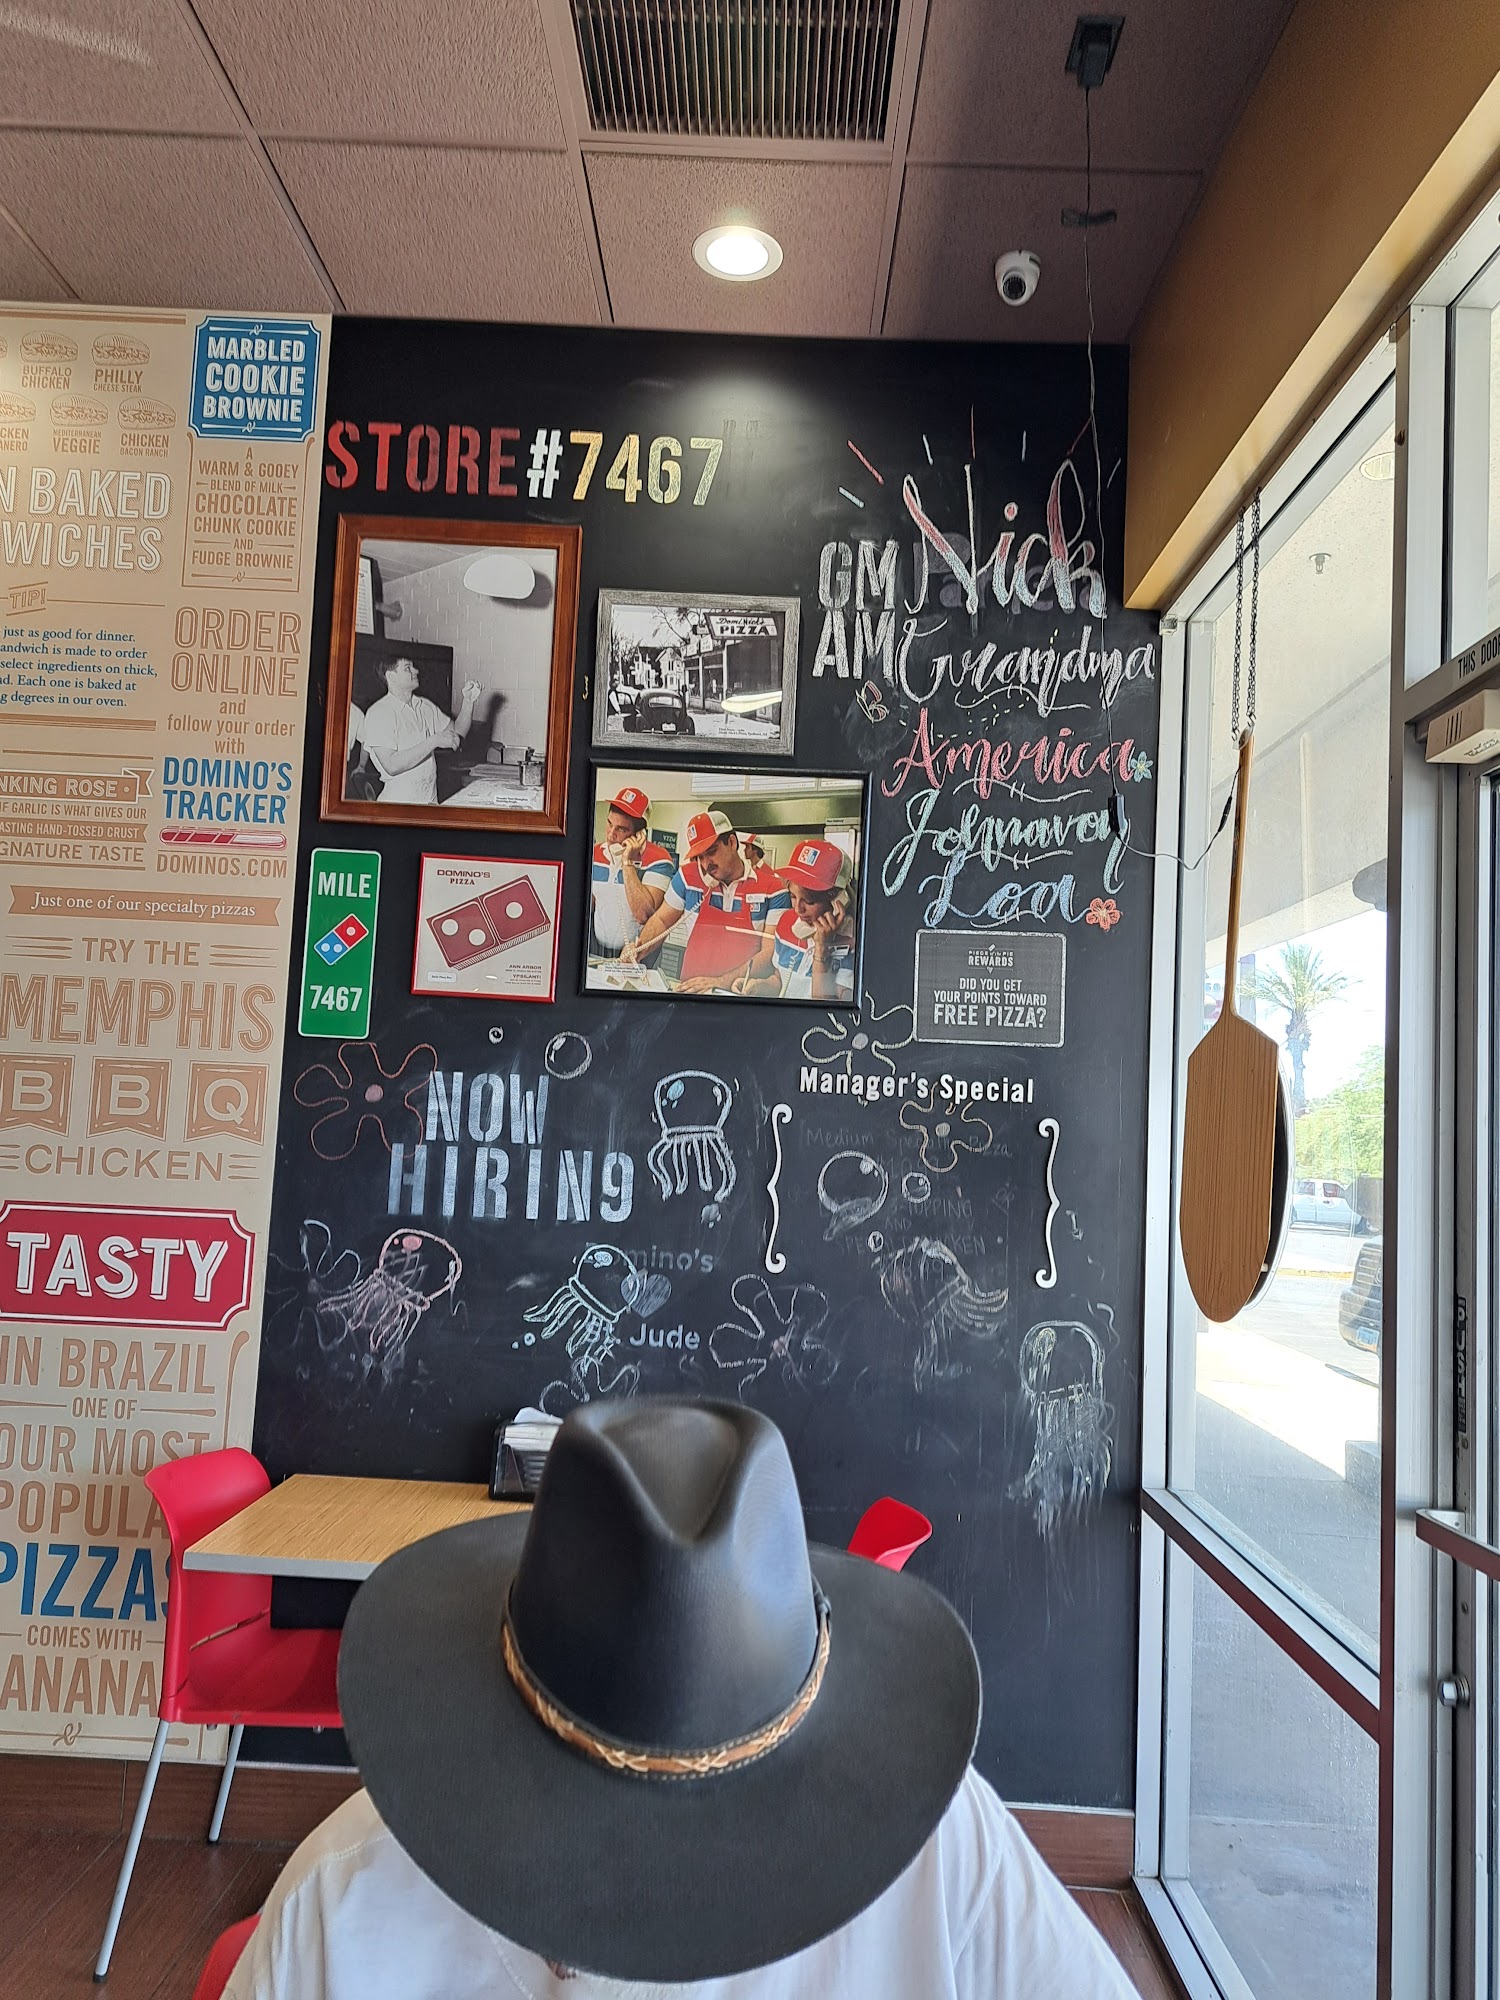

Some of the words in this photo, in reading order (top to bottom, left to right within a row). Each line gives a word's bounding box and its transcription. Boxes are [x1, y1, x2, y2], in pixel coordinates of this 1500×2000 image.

[206, 336, 306, 363] MARBLED
[22, 365, 72, 377] BUFFALO
[94, 369, 144, 384] PHILLY
[205, 363, 306, 396] COOKIE
[21, 375, 71, 390] CHICKEN
[93, 383, 119, 392] CHEESE
[120, 385, 142, 393] STEAK
[202, 395, 303, 423] BROWNIE
[52, 429, 102, 438] MEDITERRANEAN
[120, 433, 169, 448] CHICKEN
[52, 437, 101, 454] VEGGIE
[119, 448, 144, 457] BACON
[146, 448, 168, 458] RANCH
[245, 447, 253, 460] A
[198, 460, 240, 477] WARM
[243, 461, 253, 477] &
[258, 462, 300, 479] GOOEY
[28, 466, 174, 523] BAKED
[210, 479, 242, 492] BLEND
[244, 481, 256, 492] OF
[259, 481, 283, 494] MILK
[195, 493, 297, 518] CHOCOLATE
[193, 516, 241, 535] CHUNK
[246, 518, 296, 537] COOKIE
[0, 520, 165, 574] WICHES
[233, 538, 254, 551] AND
[191, 551, 231, 567] FUDGE
[235, 552, 294, 569] BROWNIE
[818, 540, 898, 611] GM
[10, 589, 46, 608] TIP!
[3, 626, 24, 639] just
[42, 629, 72, 641] good
[75, 629, 92, 640] for
[96, 630, 135, 642] dinner.
[174, 606, 302, 654] ORDER
[720, 626, 770, 635] PIZZA
[53, 644, 61, 655] is
[65, 645, 96, 656] made
[100, 647, 111, 657] to
[115, 648, 147, 659] order
[813, 609, 895, 680] AM
[1, 658, 33, 669] select
[37, 660, 102, 673] ingredients
[106, 666, 120, 674] on
[124, 664, 158, 678] thick,
[170, 651, 300, 697] ONLINE
[1458, 650, 1476, 680] THIS
[17, 675, 46, 686] Each
[50, 679, 71, 687] one
[75, 678, 84, 688] is
[87, 678, 122, 690] baked
[125, 682, 136, 691] at
[10, 691, 54, 705] degrees
[58, 693, 69, 704] in
[73, 696, 93, 705] our
[96, 697, 127, 707] oven.
[219, 699, 246, 715] and
[167, 714, 212, 733] follow
[216, 719, 250, 737] your
[254, 721, 296, 737] order
[214, 738, 245, 755] with
[882, 707, 1136, 799] America
[163, 757, 293, 791] DOMINO'S
[65, 778, 118, 798] ROSE
[12, 802, 47, 814] GARLIC
[51, 804, 61, 815] IS
[63, 805, 91, 817] WHAT
[94, 806, 123, 818] GIVES
[126, 808, 147, 820] OUR
[36, 823, 104, 837] HAND-TOSSED
[107, 827, 139, 839] CRUST
[89, 845, 144, 863] TASTE
[156, 853, 288, 878] DOMINOS.COM
[437, 869, 491, 878] DOMINO'S
[317, 871, 372, 898] MILE
[30, 891, 62, 911] Just
[66, 896, 93, 909] one
[97, 895, 115, 910] of
[116, 899, 141, 911] our
[144, 898, 209, 918] specialty
[210, 902, 256, 919] pizzas
[82, 937, 136, 963] TRY
[144, 940, 201, 967] THE
[968, 955, 1014, 967] REWARDS
[959, 977, 976, 990] DID
[980, 978, 1000, 991] YOU
[1003, 979, 1022, 991] GET
[309, 985, 362, 1012] 7467
[933, 990, 961, 1003] YOUR
[964, 992, 1001, 1005] POINTS
[1004, 993, 1047, 1006] TOWARD
[0, 972, 276, 1053] MEMPHIS
[933, 1003, 979, 1026] FREE
[985, 1005, 1047, 1029] PIZZA?
[799, 1066, 929, 1101] Manager's
[939, 1074, 1034, 1104] Special
[11, 1069, 53, 1112] B
[108, 1074, 150, 1116] B
[203, 1078, 249, 1125] Q
[425, 1071, 550, 1144] NOW
[24, 1144, 223, 1182] CHICKEN
[5, 1231, 229, 1303] TASTY
[629, 1323, 700, 1350] Jude
[58, 1337, 216, 1395] BRAZIL
[72, 1396, 108, 1419] ONE
[113, 1399, 138, 1420] OF
[0, 1422, 77, 1474] OUR
[27, 1624, 91, 1649] COMES
[96, 1627, 143, 1651] WITH
